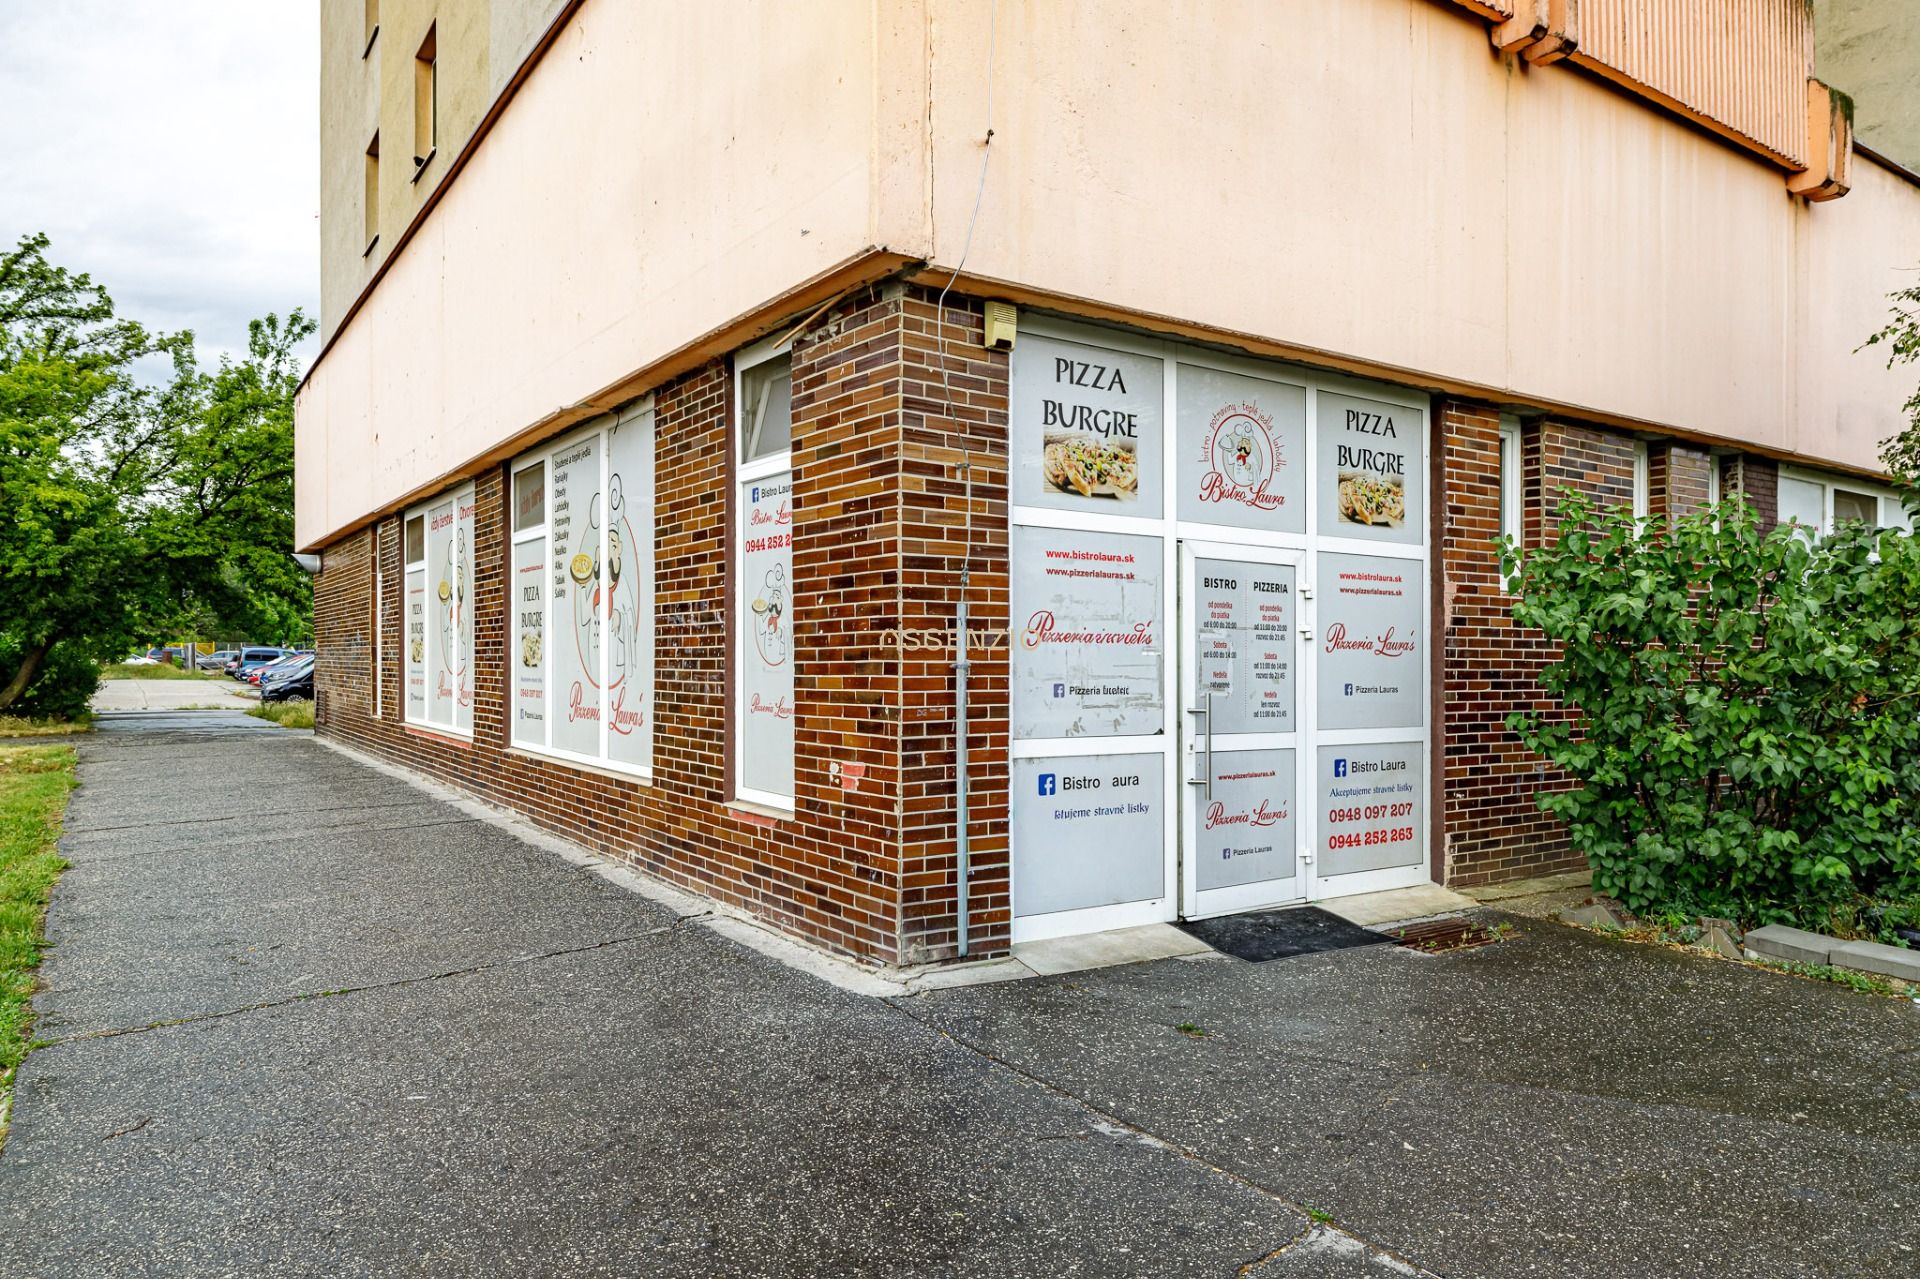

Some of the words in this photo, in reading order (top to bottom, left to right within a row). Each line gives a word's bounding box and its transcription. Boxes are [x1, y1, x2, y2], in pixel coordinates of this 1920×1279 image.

[1055, 357, 1126, 394] PIZZA
[1042, 399, 1138, 438] BURGRE
[1346, 409, 1396, 438] PIZZA
[1197, 435, 1210, 463] bistro
[1337, 444, 1405, 476] BURGRE
[762, 487, 777, 499] Bistro
[1199, 471, 1246, 503] Bistro
[1246, 479, 1286, 510] Laura
[746, 536, 765, 553] 0944
[767, 534, 783, 550] 252
[1046, 550, 1135, 563] www.bistrolaura.sk
[1046, 568, 1135, 580] www.pizzerialauras.sk
[1339, 573, 1402, 583] www.bistrolaura.sk
[1204, 577, 1237, 590] BISTRO
[1253, 581, 1288, 594] PIZZERIA
[523, 585, 540, 602] PIZZA
[1326, 623, 1374, 653] Pizzeria
[1069, 685, 1101, 696] Pizzeria
[1356, 685, 1378, 694] Pizzeria
[1351, 760, 1378, 773] Bistro
[1380, 760, 1406, 772] Laura
[1063, 776, 1101, 791] Bistro
[1329, 786, 1371, 798] Akceptujeme
[1094, 803, 1125, 816] stravné
[1206, 801, 1249, 830] Pizzeria
[1329, 807, 1361, 823] 0948
[1364, 804, 1387, 820] 097
[1390, 802, 1413, 817] 207
[1329, 833, 1361, 849] 0944
[1364, 829, 1387, 846] 252
[1390, 827, 1413, 842] 263
